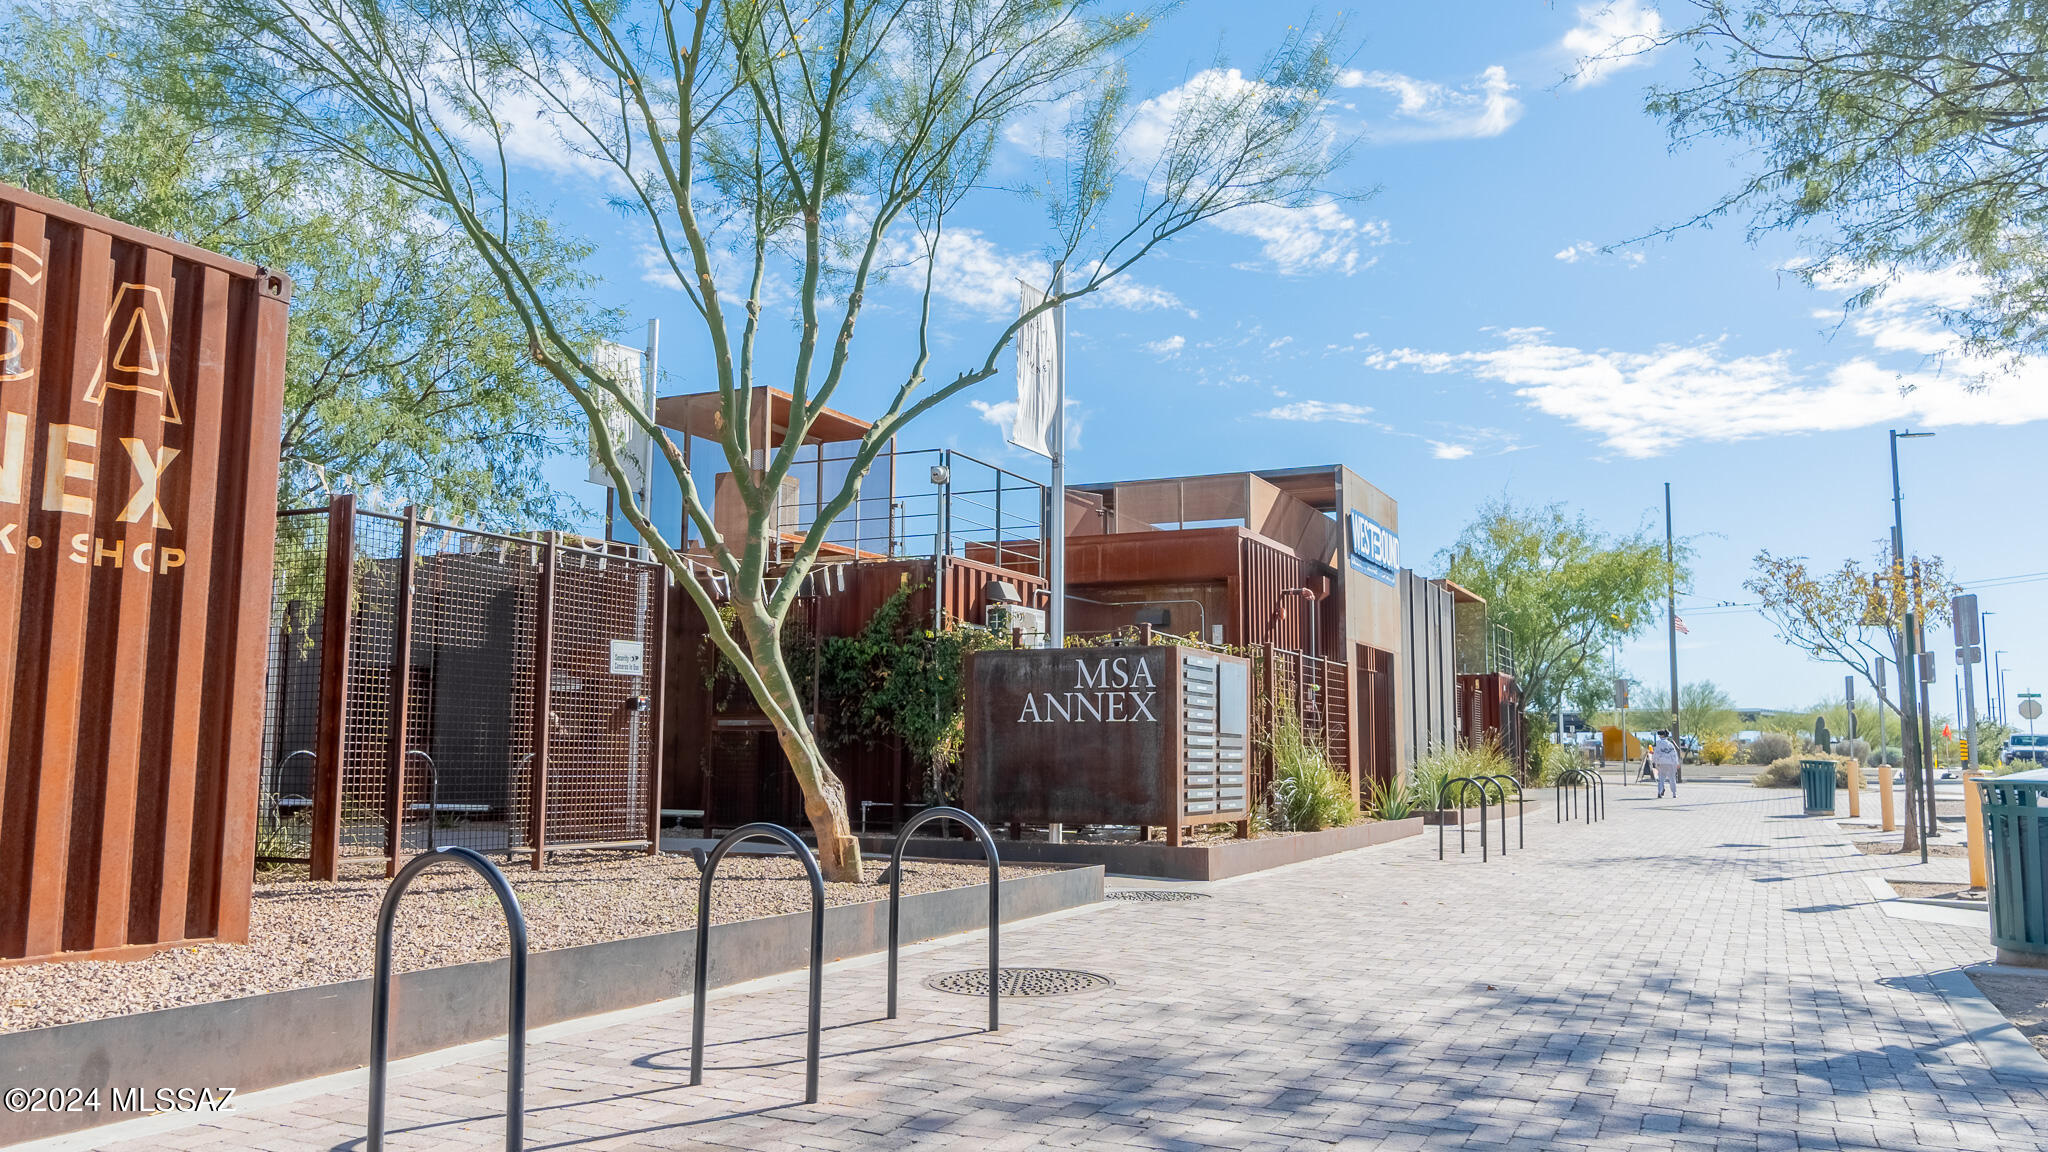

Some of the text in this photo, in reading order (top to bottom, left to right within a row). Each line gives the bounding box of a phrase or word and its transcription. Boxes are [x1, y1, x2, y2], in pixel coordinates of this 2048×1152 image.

[69, 533, 186, 575] SHOP
[1351, 511, 1400, 570] WESTBOUND
[1074, 656, 1156, 689] MSA
[1017, 691, 1157, 723] ANNEX
